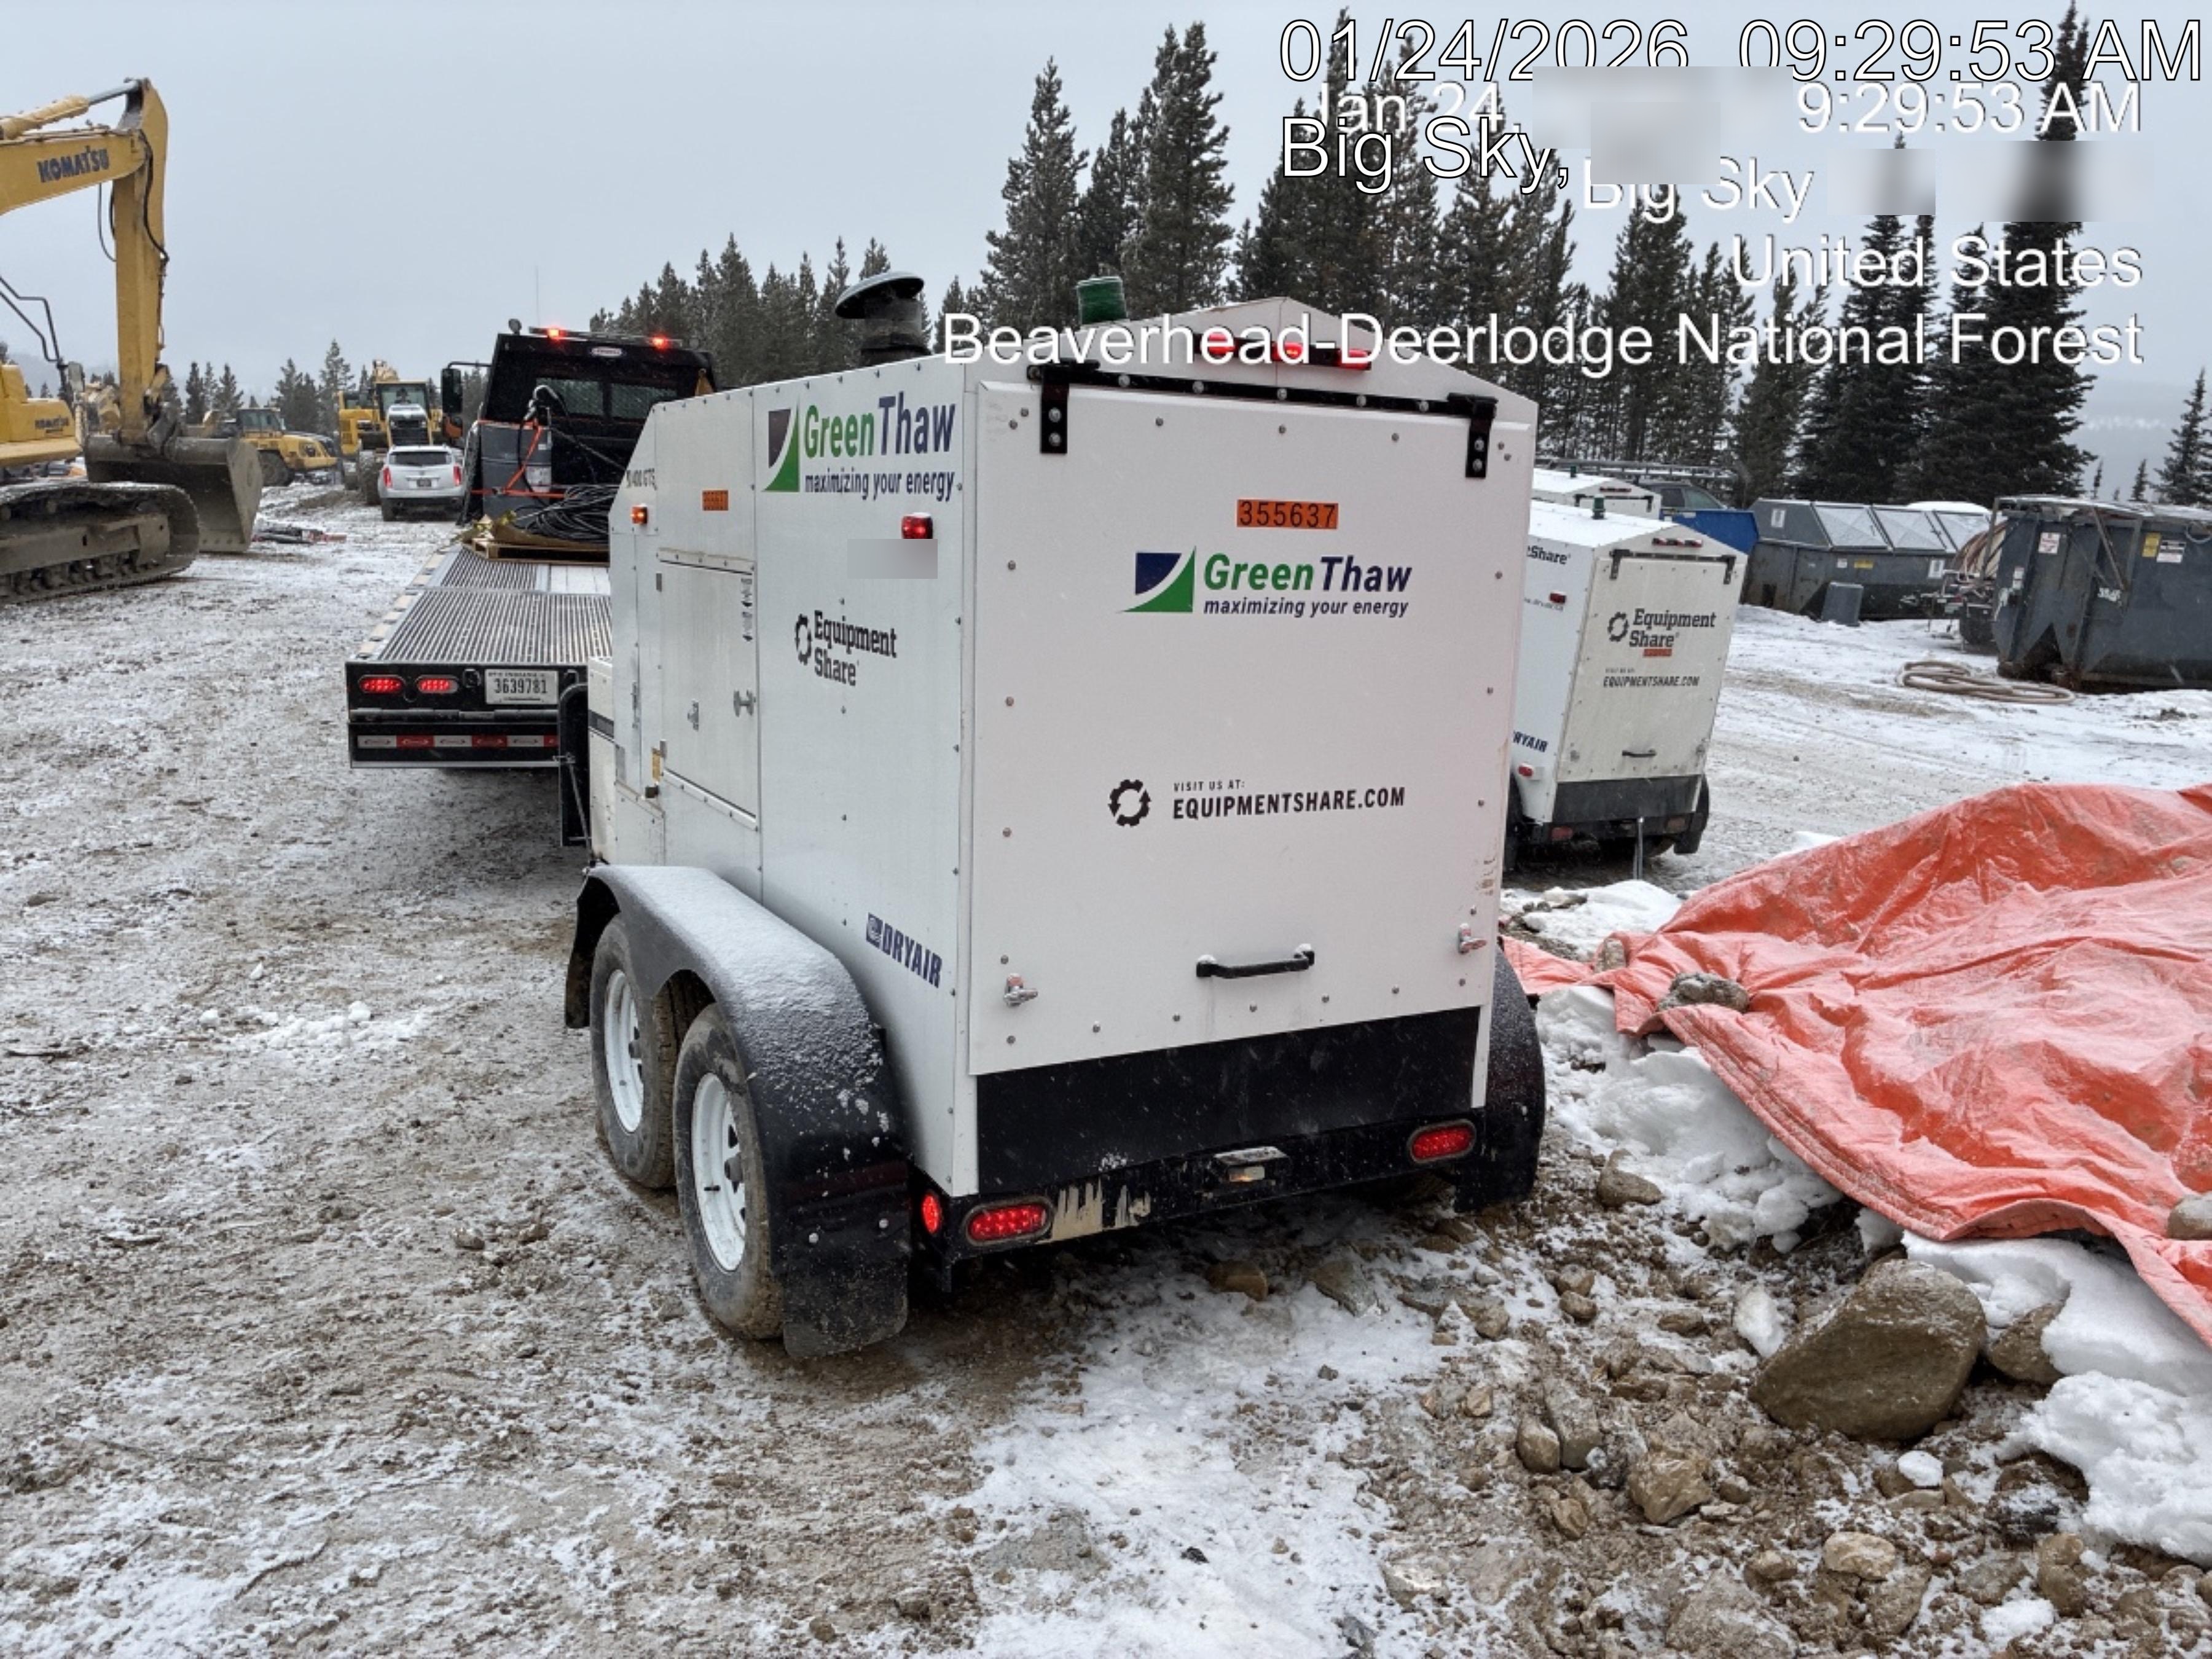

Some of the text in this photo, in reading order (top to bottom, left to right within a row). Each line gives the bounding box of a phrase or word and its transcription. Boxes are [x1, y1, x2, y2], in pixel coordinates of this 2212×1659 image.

[37, 145, 109, 182] KOMATSU
[805, 467, 955, 502] maximizing your energy
[1239, 500, 1336, 528] 355637
[1203, 597, 1410, 618] maximizing your energy
[1633, 608, 1717, 630] Equipment
[814, 610, 897, 659] Equipment
[1629, 630, 1674, 648] Share
[814, 646, 856, 687] Share
[494, 678, 547, 694] 3639781
[1174, 780, 1245, 792] VISIT US AT:
[1173, 787, 1406, 820] EQUIPMENTSHARE.COM
[882, 922, 943, 989] DRYAIR
